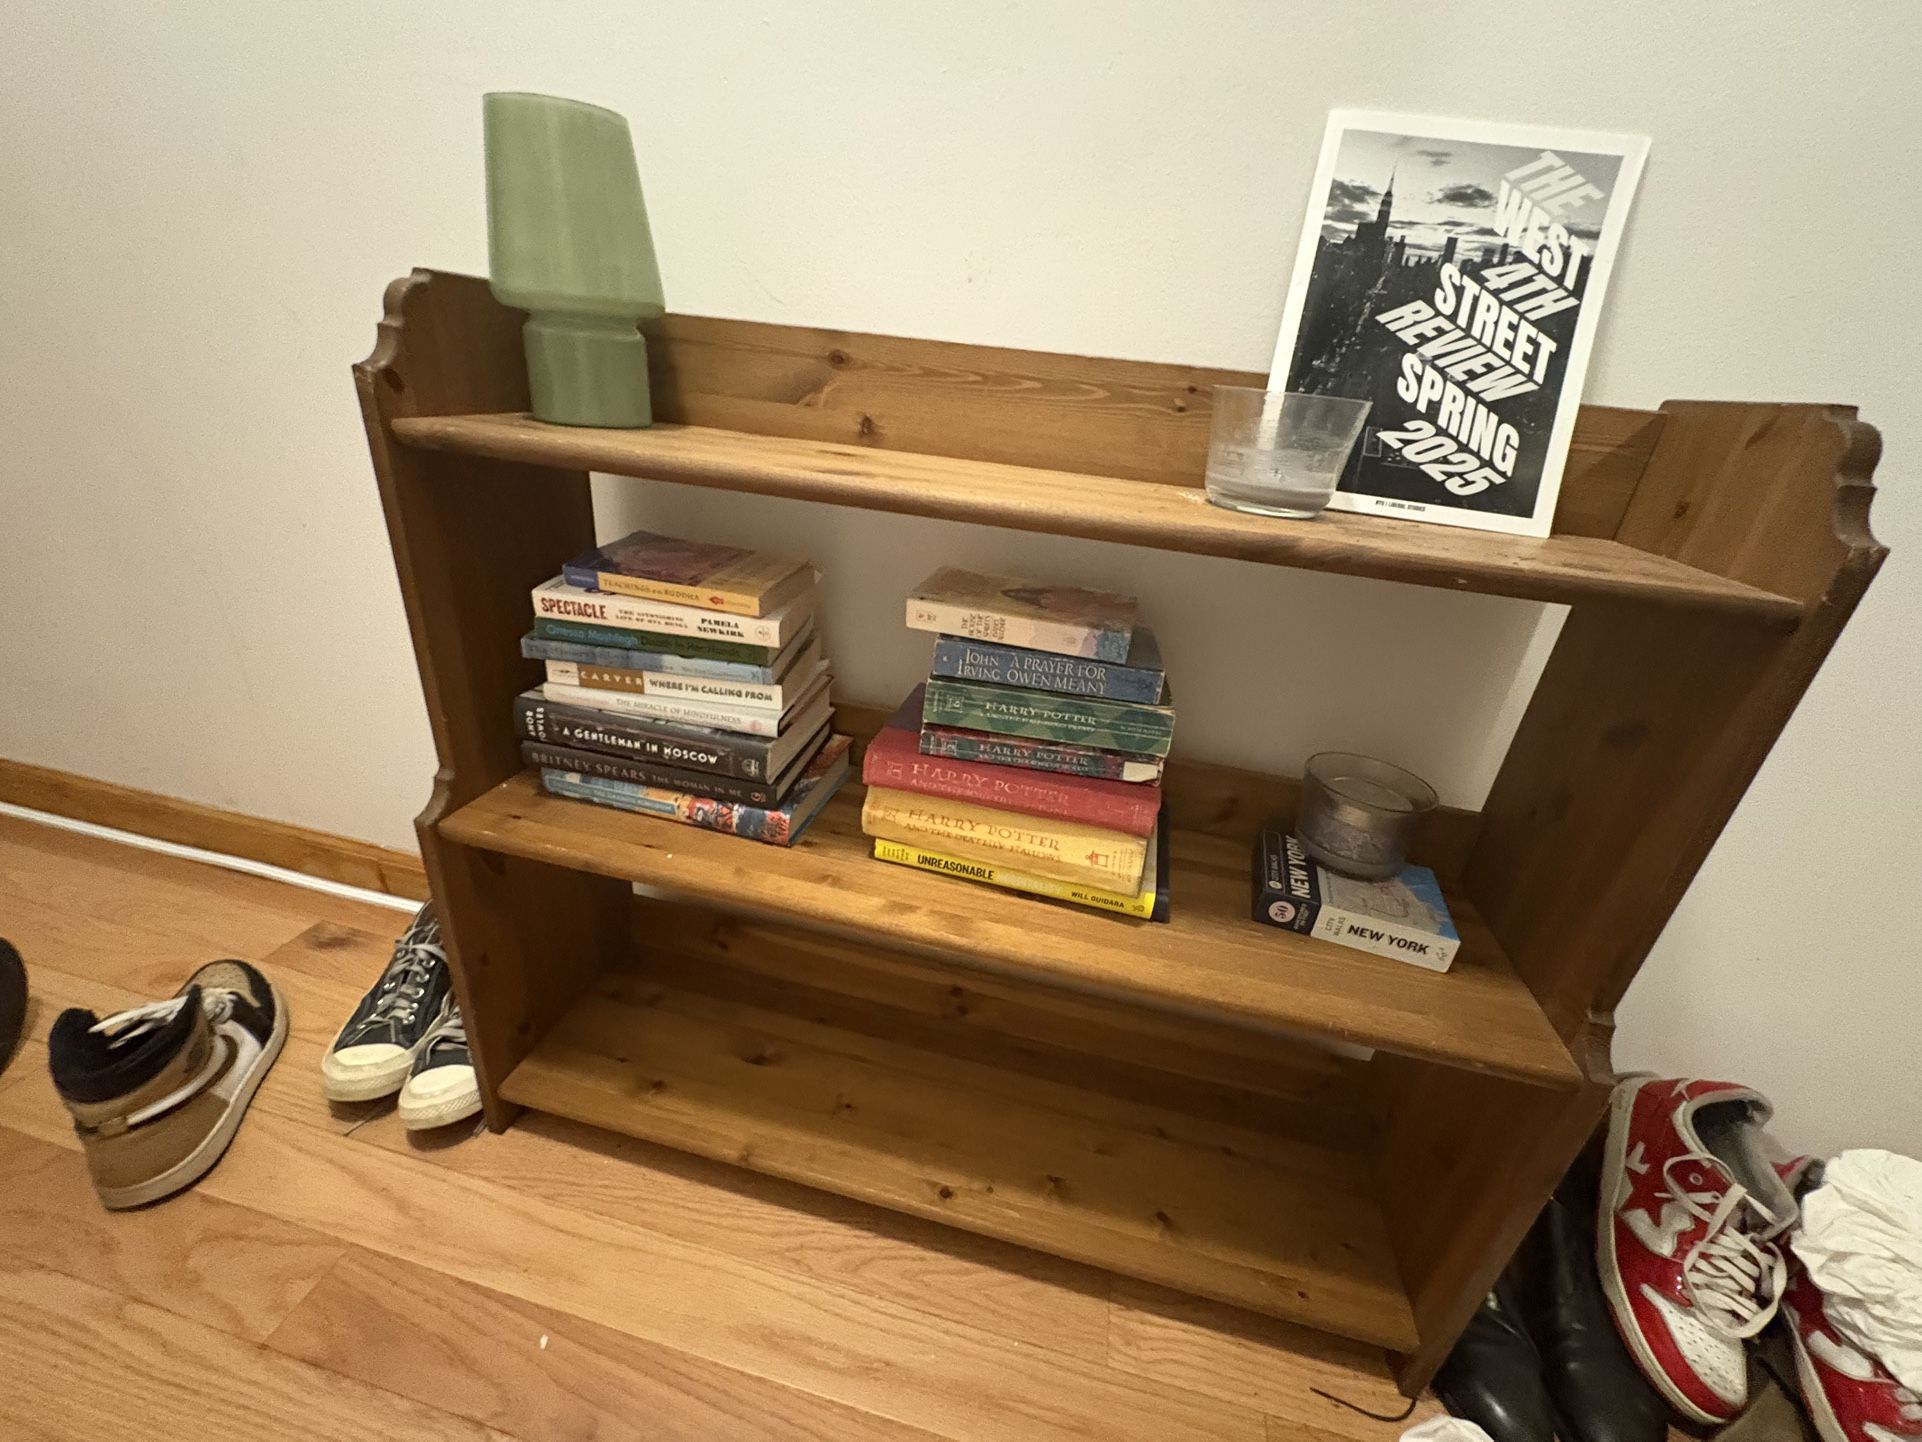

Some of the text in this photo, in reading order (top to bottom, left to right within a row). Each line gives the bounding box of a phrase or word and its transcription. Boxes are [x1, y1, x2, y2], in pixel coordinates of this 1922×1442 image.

[1503, 150, 1605, 214] THE
[1494, 180, 1591, 291] WEST
[1480, 262, 1580, 321] 4TH
[1434, 263, 1557, 384] STREET
[1375, 300, 1541, 402] REVIEW
[1397, 352, 1520, 477] SPRING
[1376, 420, 1506, 495] 2025
[664, 589, 699, 601] BUDDHA
[540, 597, 608, 620] SPECTACLE
[697, 625, 744, 638] NEWKIRK
[701, 618, 739, 629] PAMELA
[958, 659, 1000, 680] IRVING
[966, 648, 999, 666] JOHN
[1009, 656, 1106, 680] A PRAYER FOR
[581, 671, 642, 686] CARVER
[649, 679, 773, 702] WHERE I'M CALLING FROM
[1007, 670, 1106, 695] OWEN MEANY
[526, 711, 536, 736] AMOR
[616, 698, 631, 706] THE
[633, 701, 667, 712] MIRACLE
[683, 709, 743, 724] MINDFULNESS
[986, 702, 1038, 716] HARRY
[1043, 711, 1097, 725] POTTER
[563, 727, 718, 764] A GENTLEMAN IN MOSCOW
[980, 744, 1032, 756] HARRY
[1036, 751, 1088, 765] POTTER
[532, 752, 646, 780] BRITNEY SPEARS
[652, 774, 742, 797] THE WOMAN IN ME
[911, 763, 988, 788] HARRY
[994, 780, 1069, 806] POTTER
[904, 823, 928, 832] AND
[930, 828, 952, 839] THE
[908, 809, 1060, 851] HARRY POTTER
[1286, 835, 1307, 866] YORK
[917, 854, 995, 880] UNREASONABLE
[1289, 866, 1311, 899] NEW
[1071, 891, 1125, 909] WILL GUIDARA
[1274, 905, 1288, 919] 50
[1325, 918, 1335, 931] CITY
[1347, 925, 1430, 955] NEW YORK
